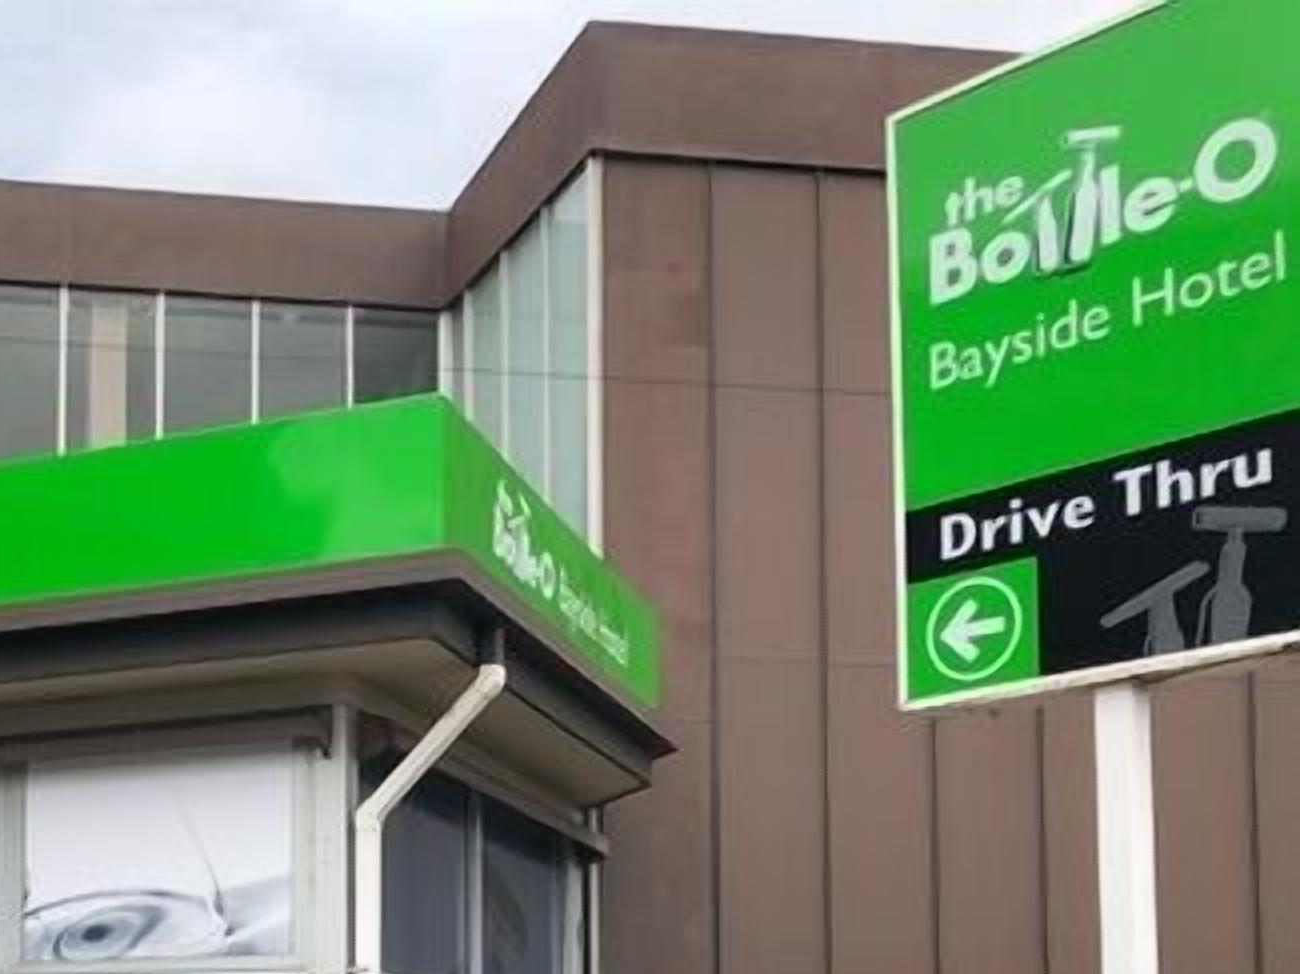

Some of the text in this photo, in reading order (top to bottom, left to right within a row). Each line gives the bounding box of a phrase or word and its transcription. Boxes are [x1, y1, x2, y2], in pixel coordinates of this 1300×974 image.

[929, 117, 1278, 306] Bottle-O
[945, 175, 1025, 225] the
[929, 229, 1286, 390] Bayside Hotel
[939, 448, 1274, 560] Drive Thru
